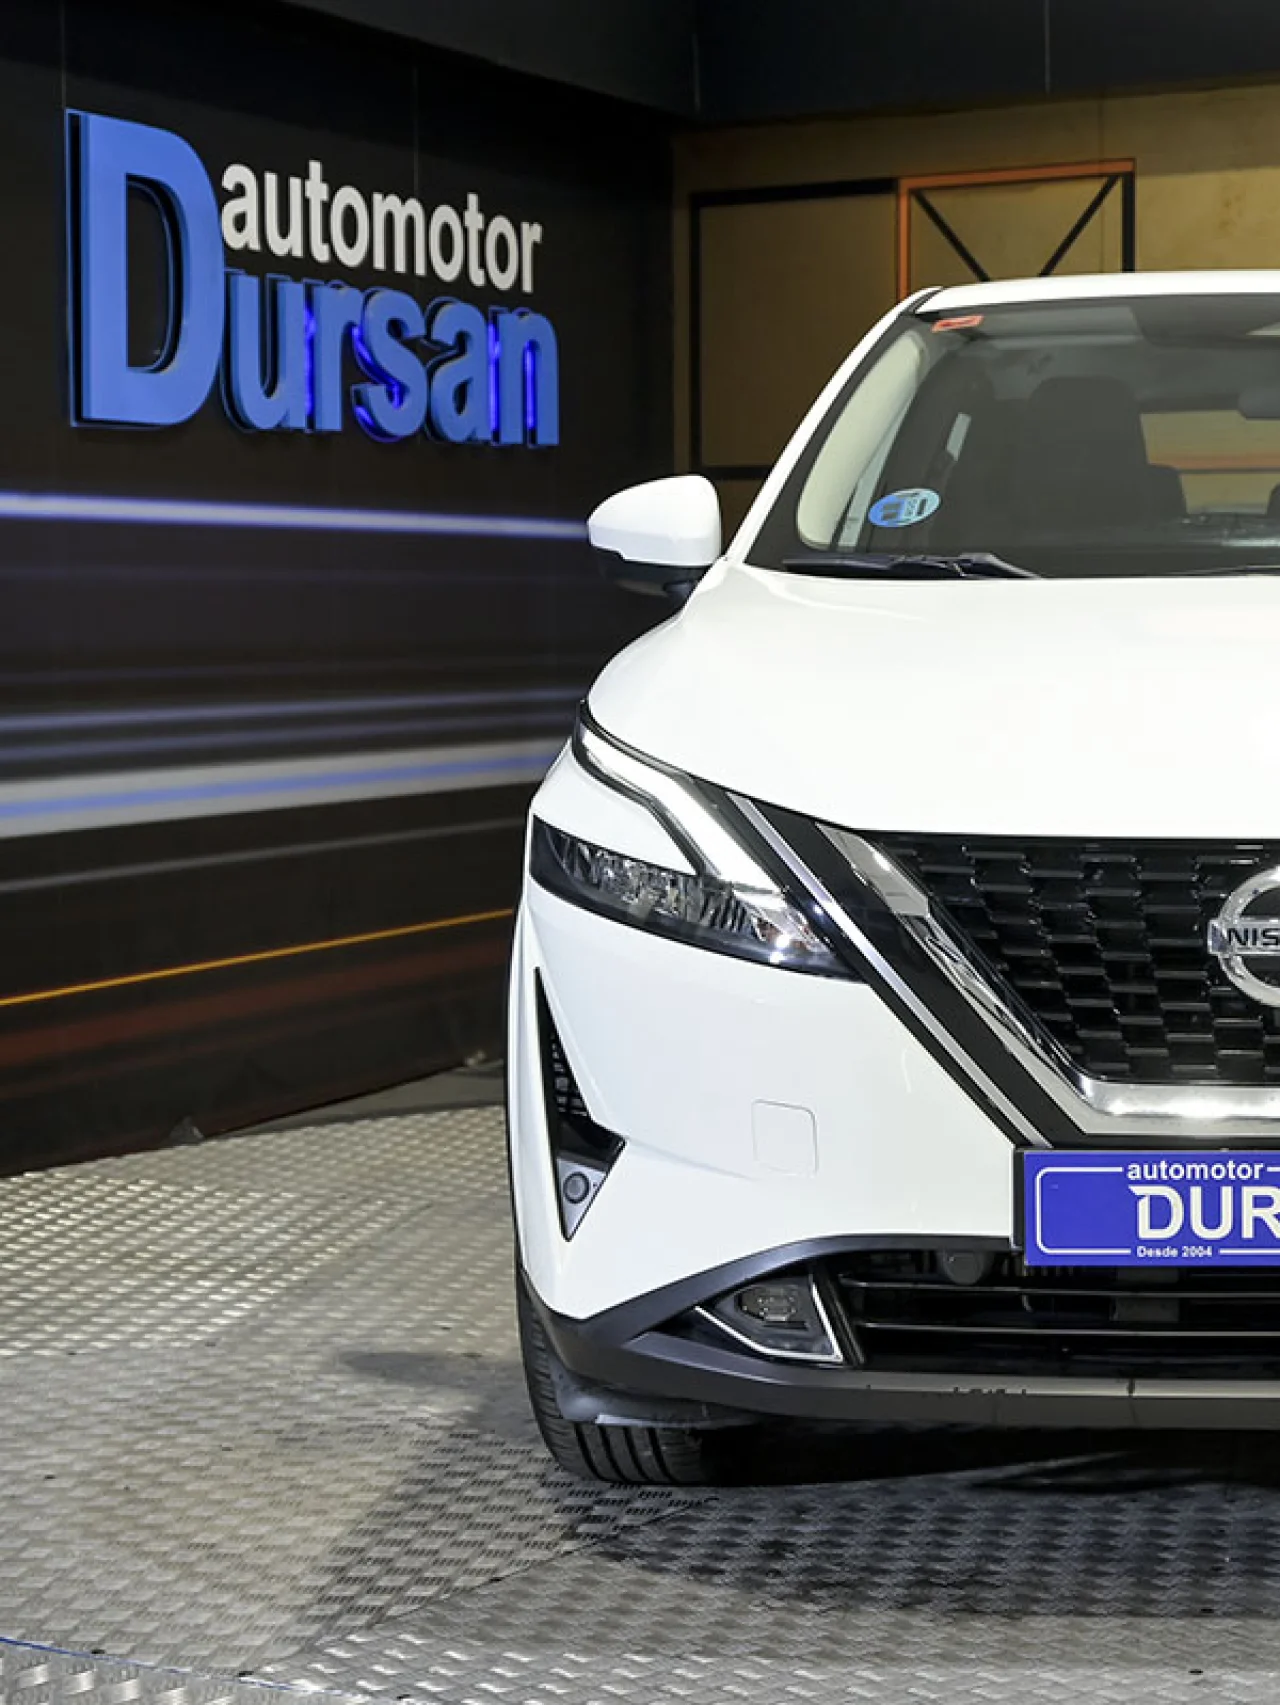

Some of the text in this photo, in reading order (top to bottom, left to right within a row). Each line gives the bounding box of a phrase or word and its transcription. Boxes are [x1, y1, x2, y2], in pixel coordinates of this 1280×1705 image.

[221, 160, 542, 293] automotor
[66, 108, 560, 447] Dursan
[1127, 1160, 1264, 1180] automotor
[1136, 1245, 1213, 1258] Desde 2004
